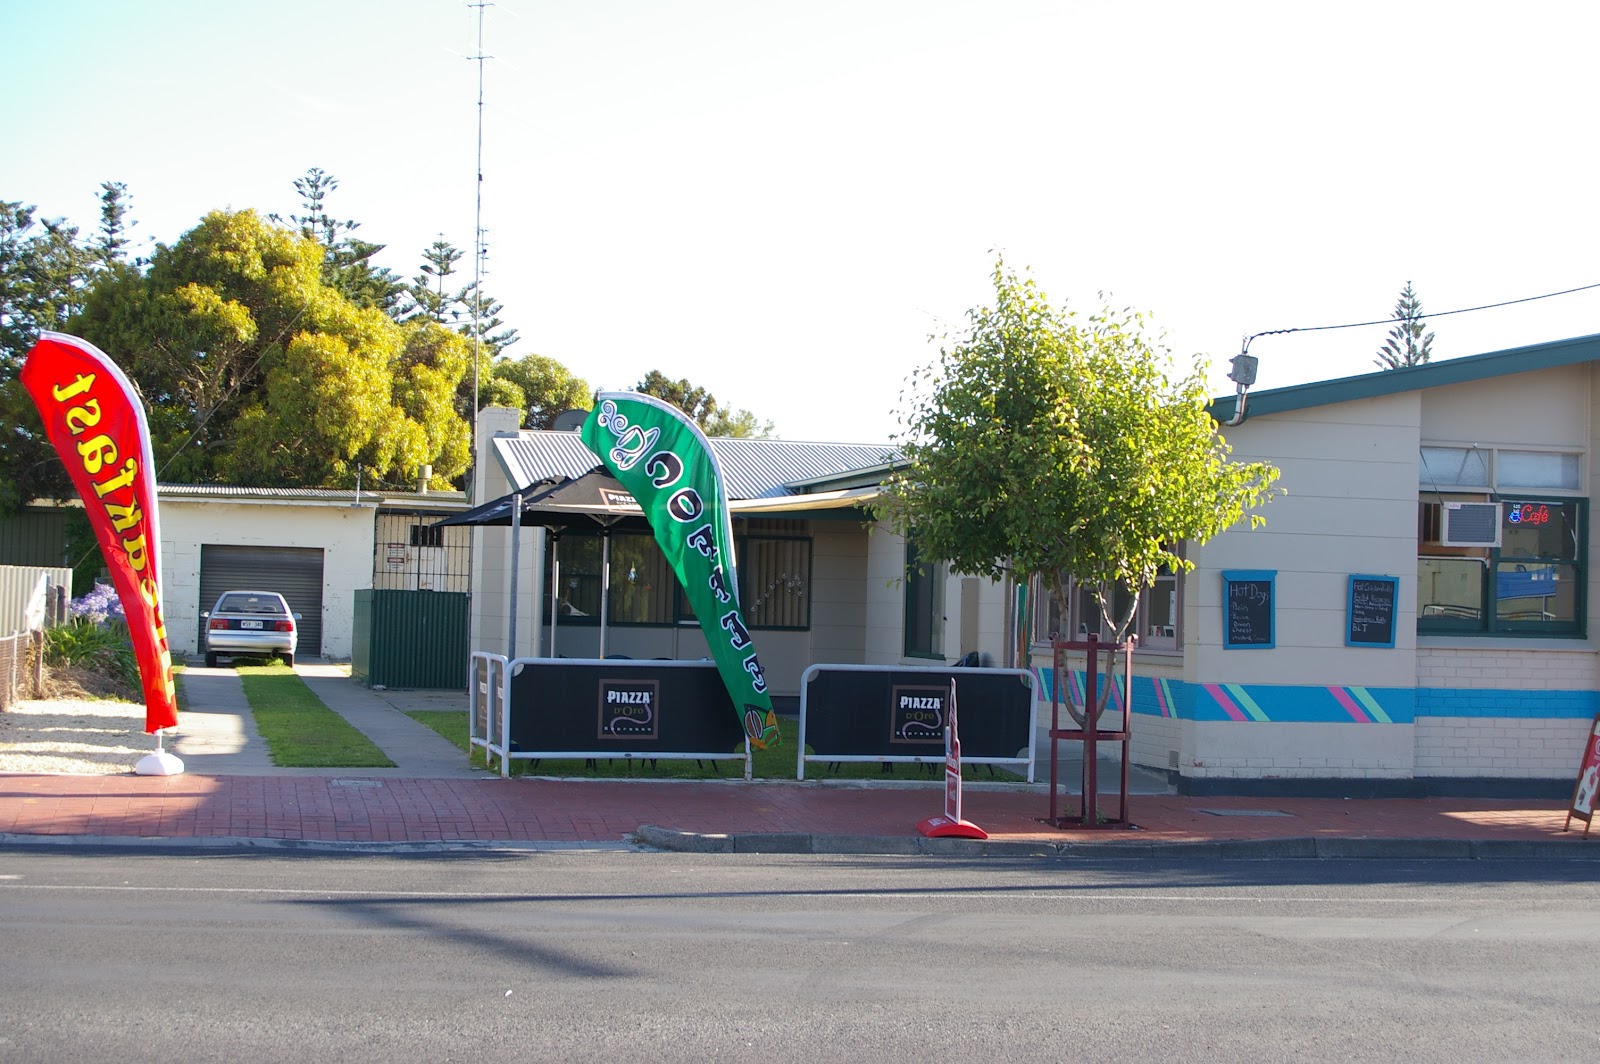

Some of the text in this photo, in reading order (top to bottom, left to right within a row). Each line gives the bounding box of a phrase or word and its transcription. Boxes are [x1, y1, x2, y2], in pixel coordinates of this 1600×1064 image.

[607, 493, 638, 503] PIAZZ
[1230, 584, 1249, 598] Hot
[1352, 623, 1369, 633] BLT
[606, 690, 651, 704] PIAZZA
[899, 696, 941, 710] PIAZZA
